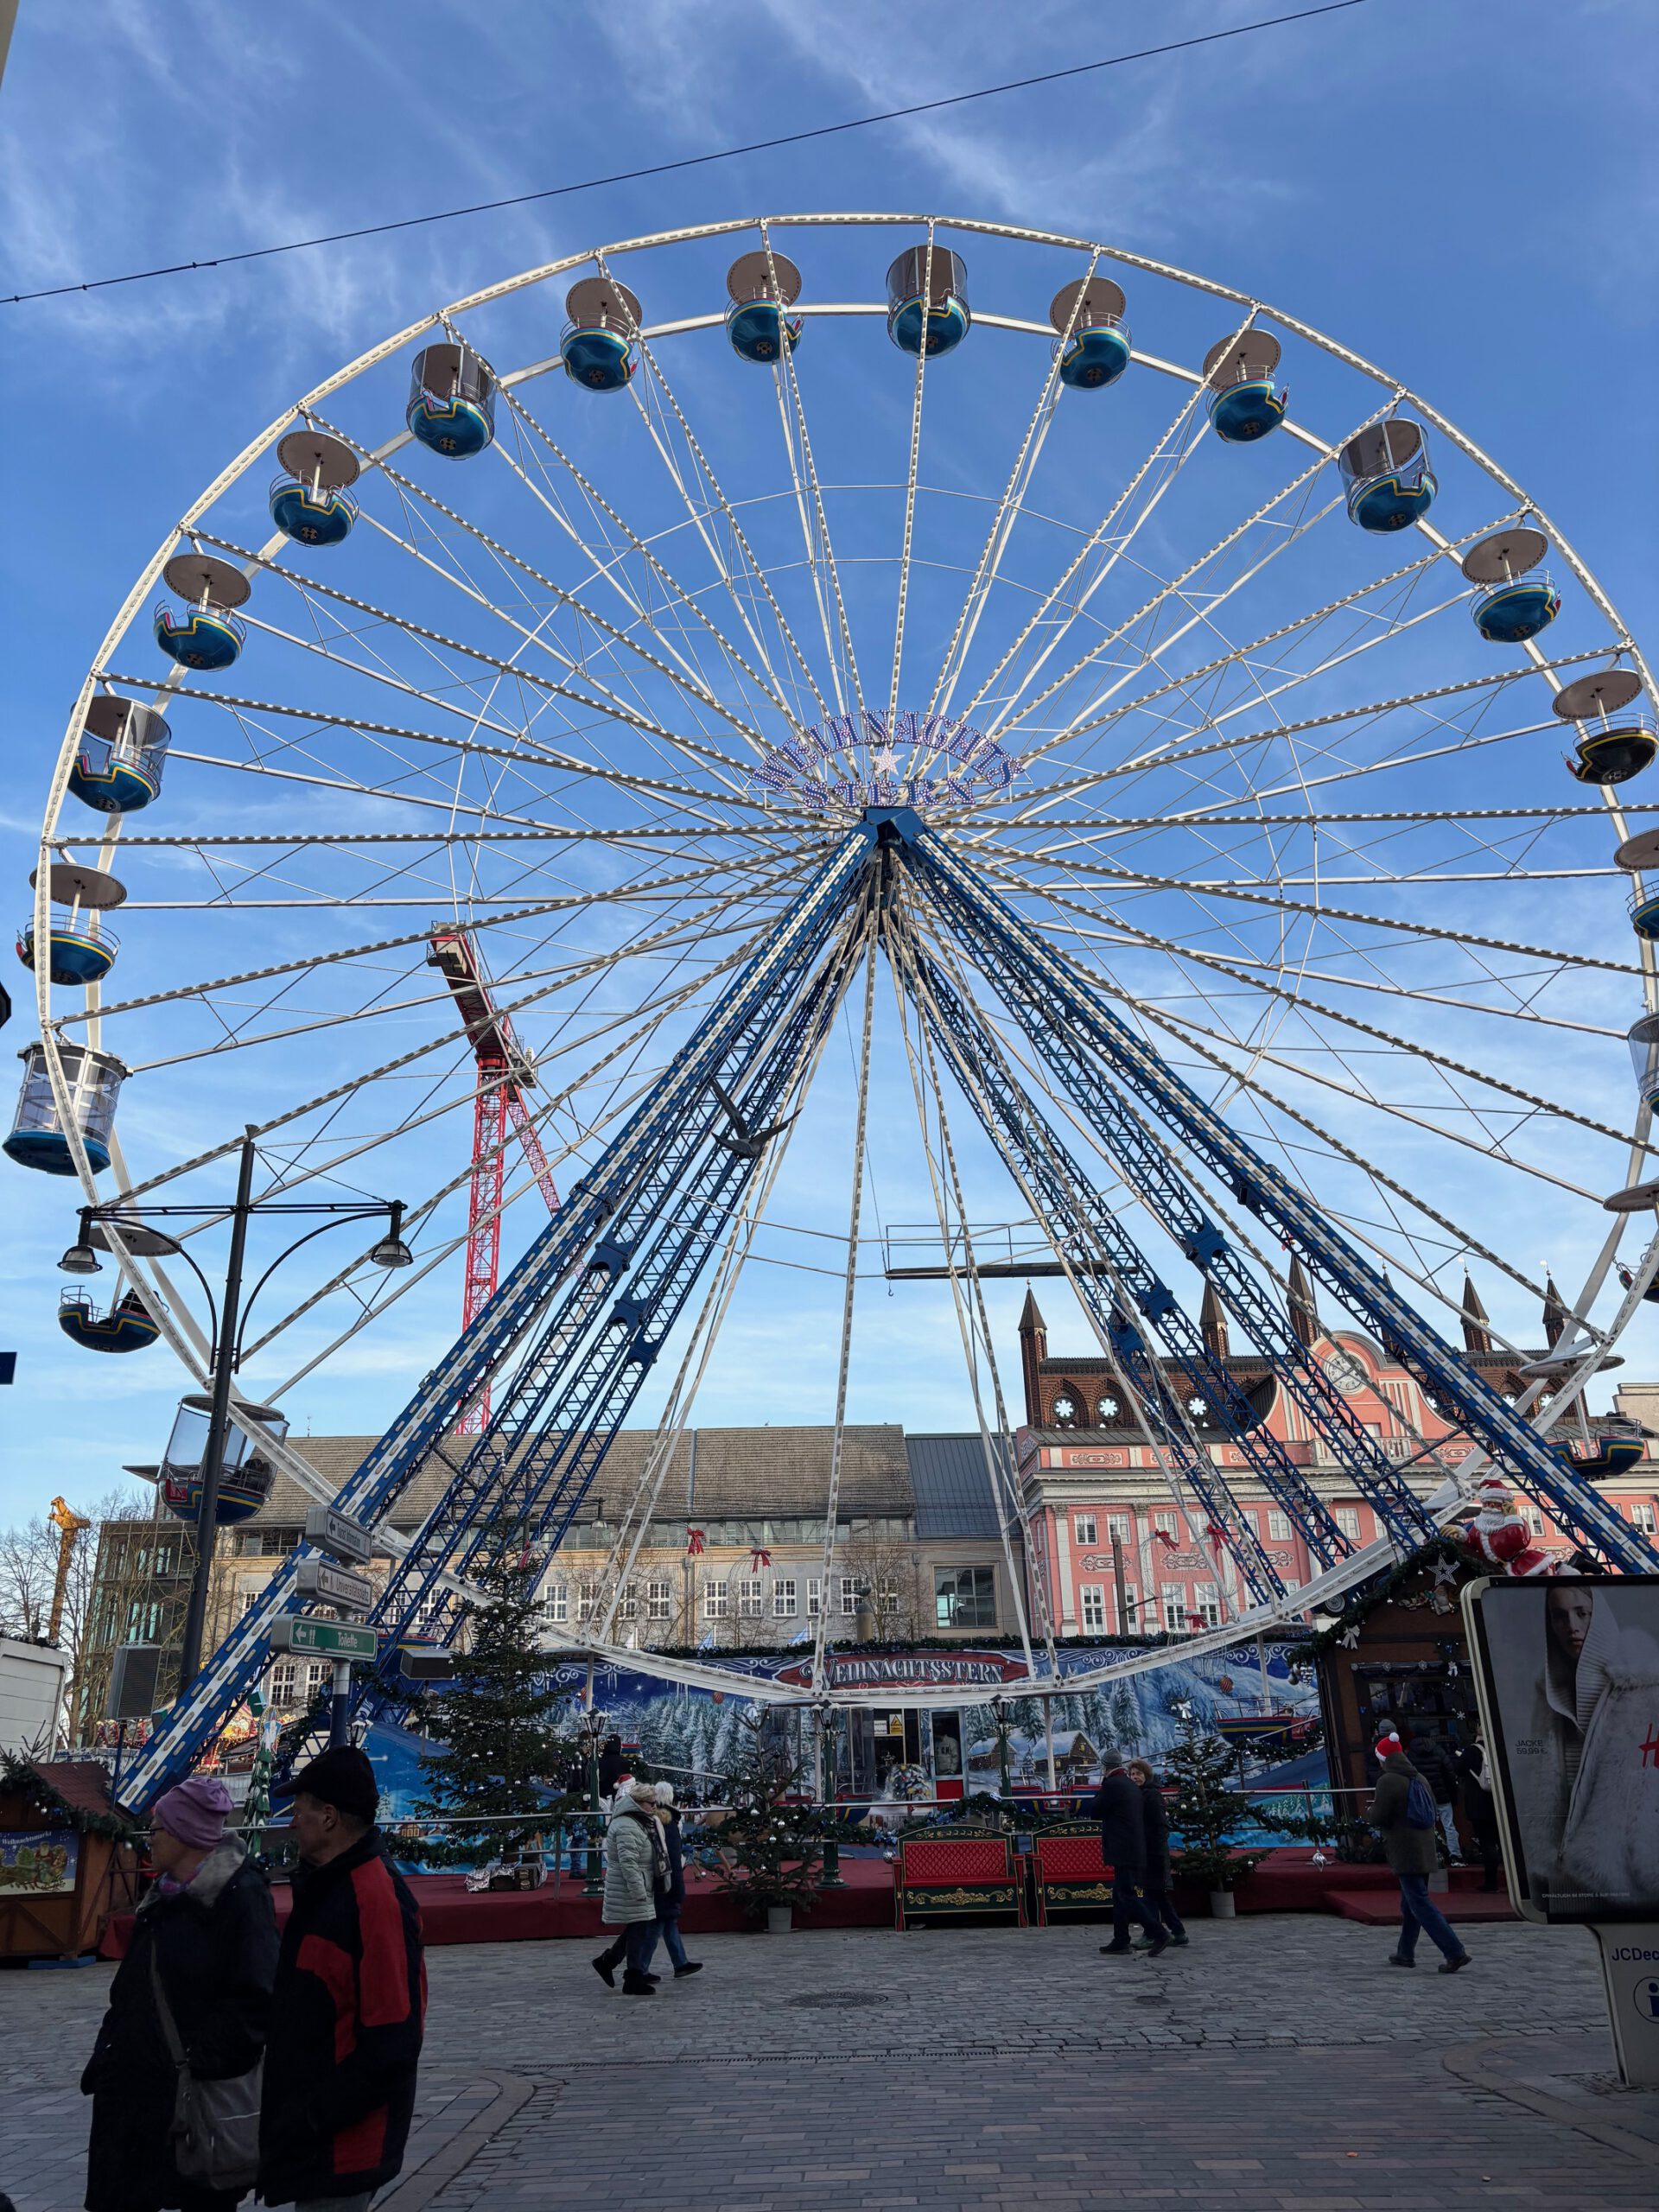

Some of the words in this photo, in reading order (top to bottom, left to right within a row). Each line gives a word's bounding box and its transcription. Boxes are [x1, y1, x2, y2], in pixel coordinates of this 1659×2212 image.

[748, 709, 1025, 792] WEIHNACHTS
[801, 778, 976, 809] STERN
[336, 1576, 369, 1602] Universitätsplatz
[337, 1631, 358, 1649] Toilette
[2, 1830, 52, 1845] Weihnachtsmarkt
